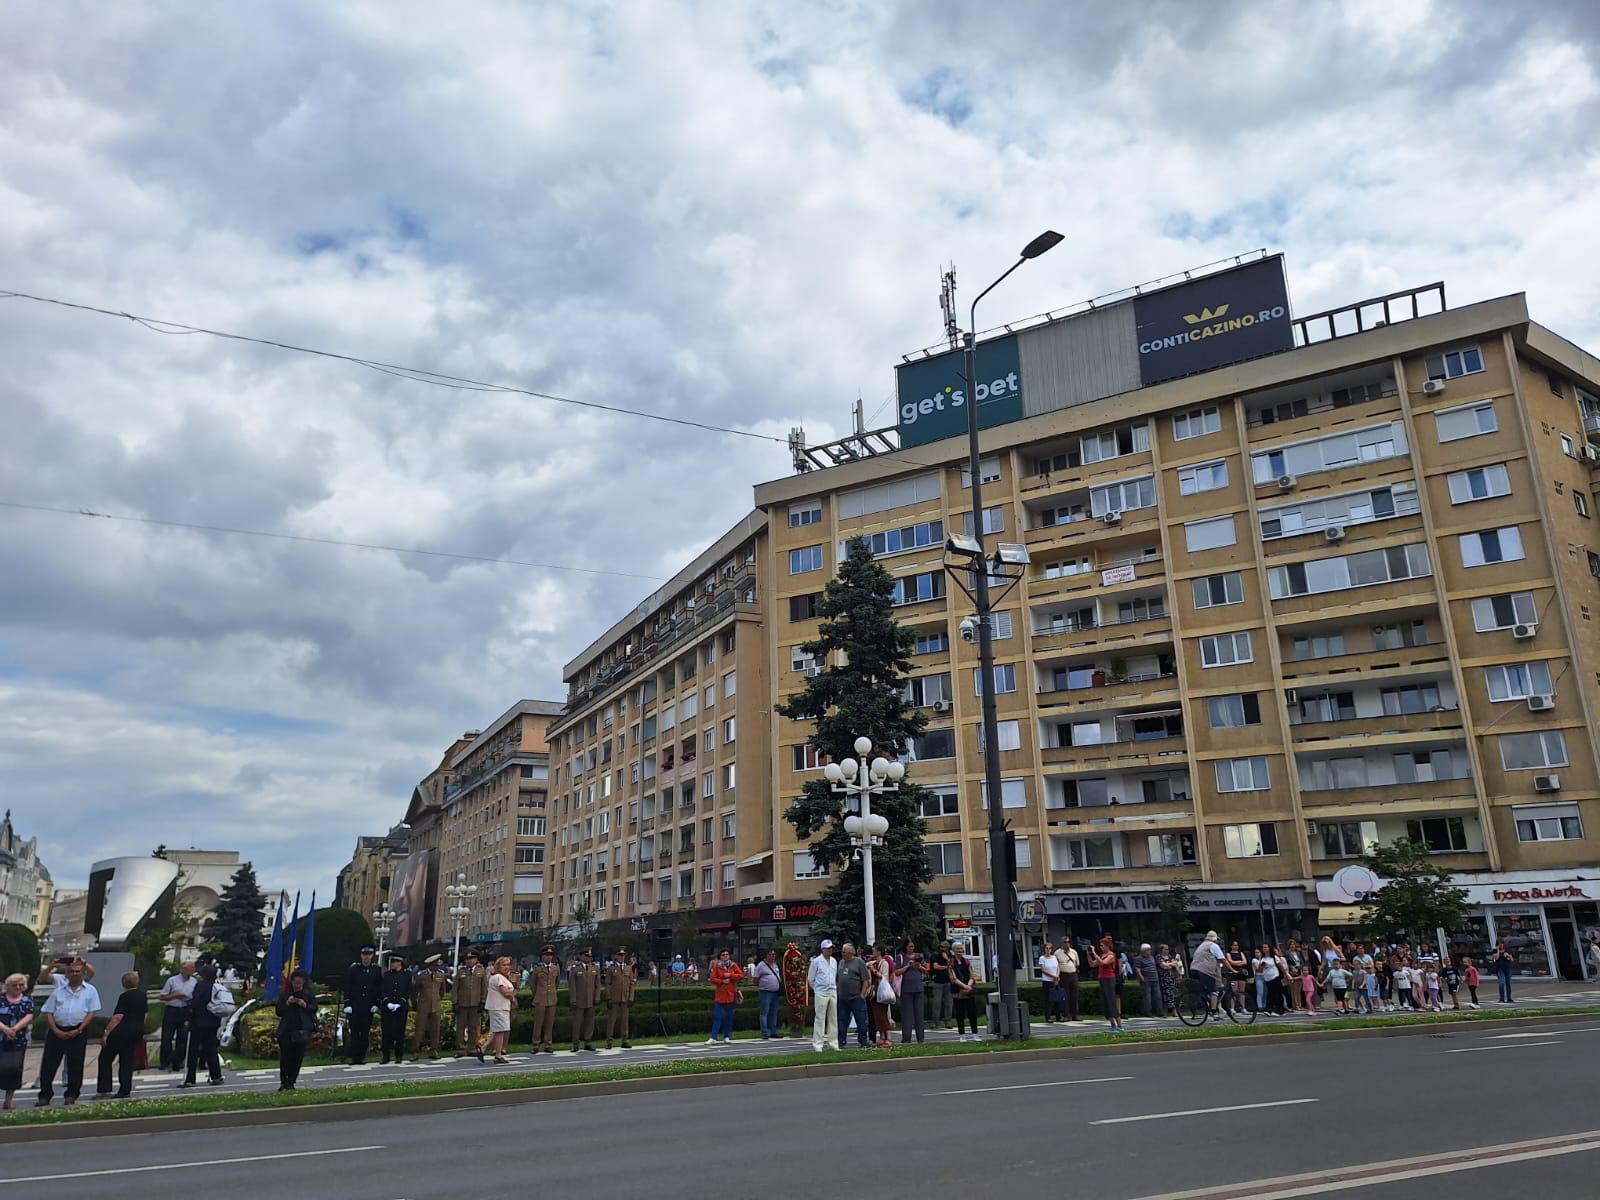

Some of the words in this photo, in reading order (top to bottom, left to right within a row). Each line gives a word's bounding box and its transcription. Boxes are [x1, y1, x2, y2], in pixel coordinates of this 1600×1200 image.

[1139, 305, 1285, 354] CONTICAZINO.RO
[976, 371, 1018, 401] bet
[1022, 903, 1035, 920] 15
[1060, 896, 1127, 911] CINEMA
